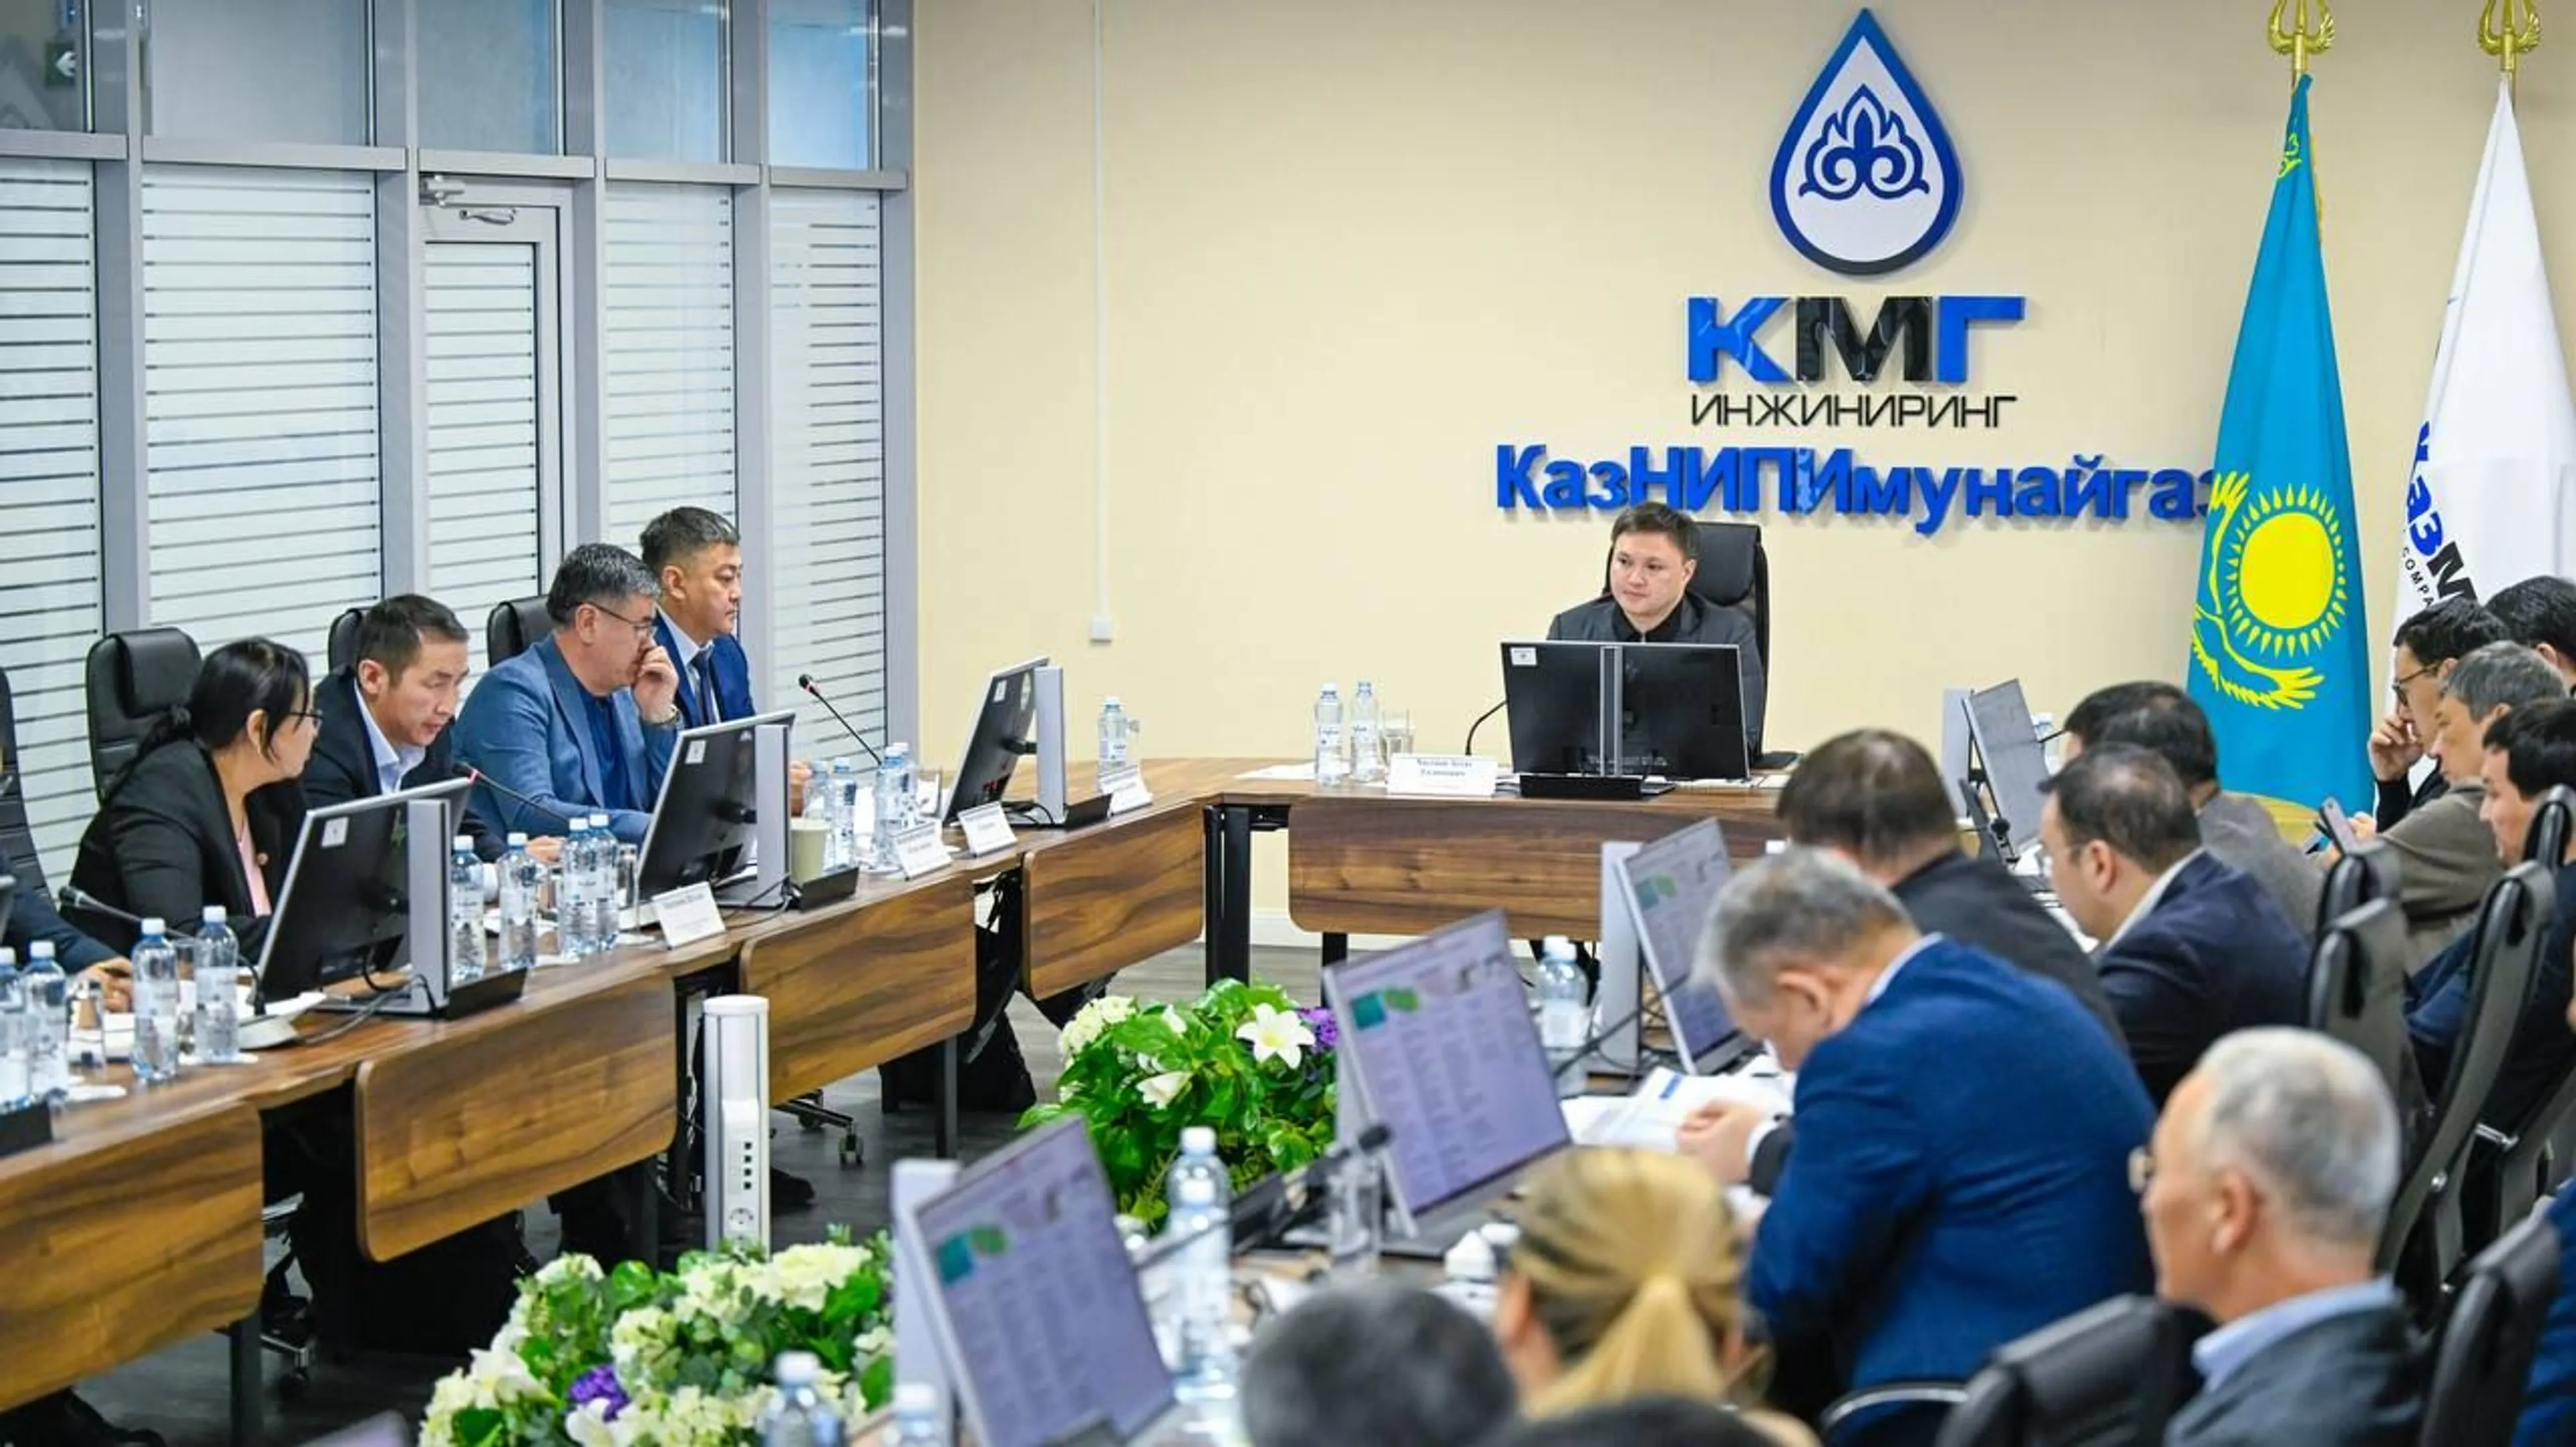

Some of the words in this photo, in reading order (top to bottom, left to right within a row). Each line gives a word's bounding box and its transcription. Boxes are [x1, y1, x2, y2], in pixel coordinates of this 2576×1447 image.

[1688, 295, 2026, 384] КМГ
[1691, 394, 2018, 428] ИНЖИНИРИНГ
[2402, 547, 2434, 606] COMPA
